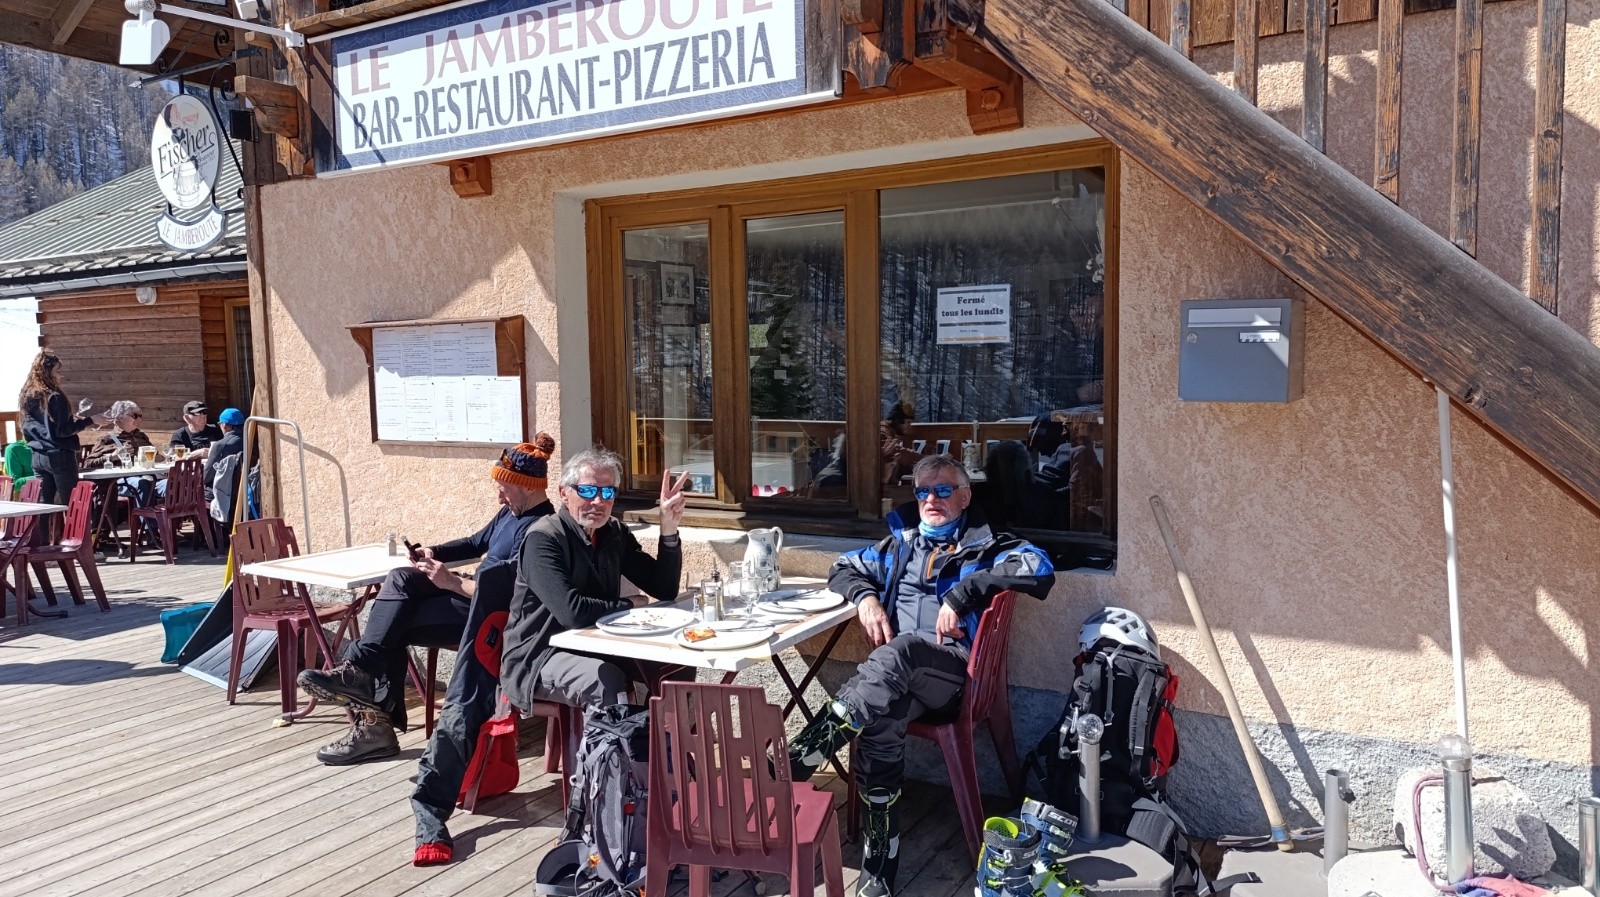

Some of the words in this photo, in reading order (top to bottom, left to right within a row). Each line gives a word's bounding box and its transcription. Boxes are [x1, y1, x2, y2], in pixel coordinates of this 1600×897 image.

[350, 44, 391, 95] LE
[422, 0, 773, 86] JAMBEROU
[352, 21, 775, 150] BAR-RESTAURANT-PIZZERIA
[157, 124, 210, 174] Fischer
[163, 220, 171, 238] LE
[174, 216, 218, 245] JAMBEROUTE
[941, 309, 959, 317] tous
[960, 308, 973, 317] les
[974, 307, 1004, 316] lundis
[957, 295, 986, 305] Fermé
